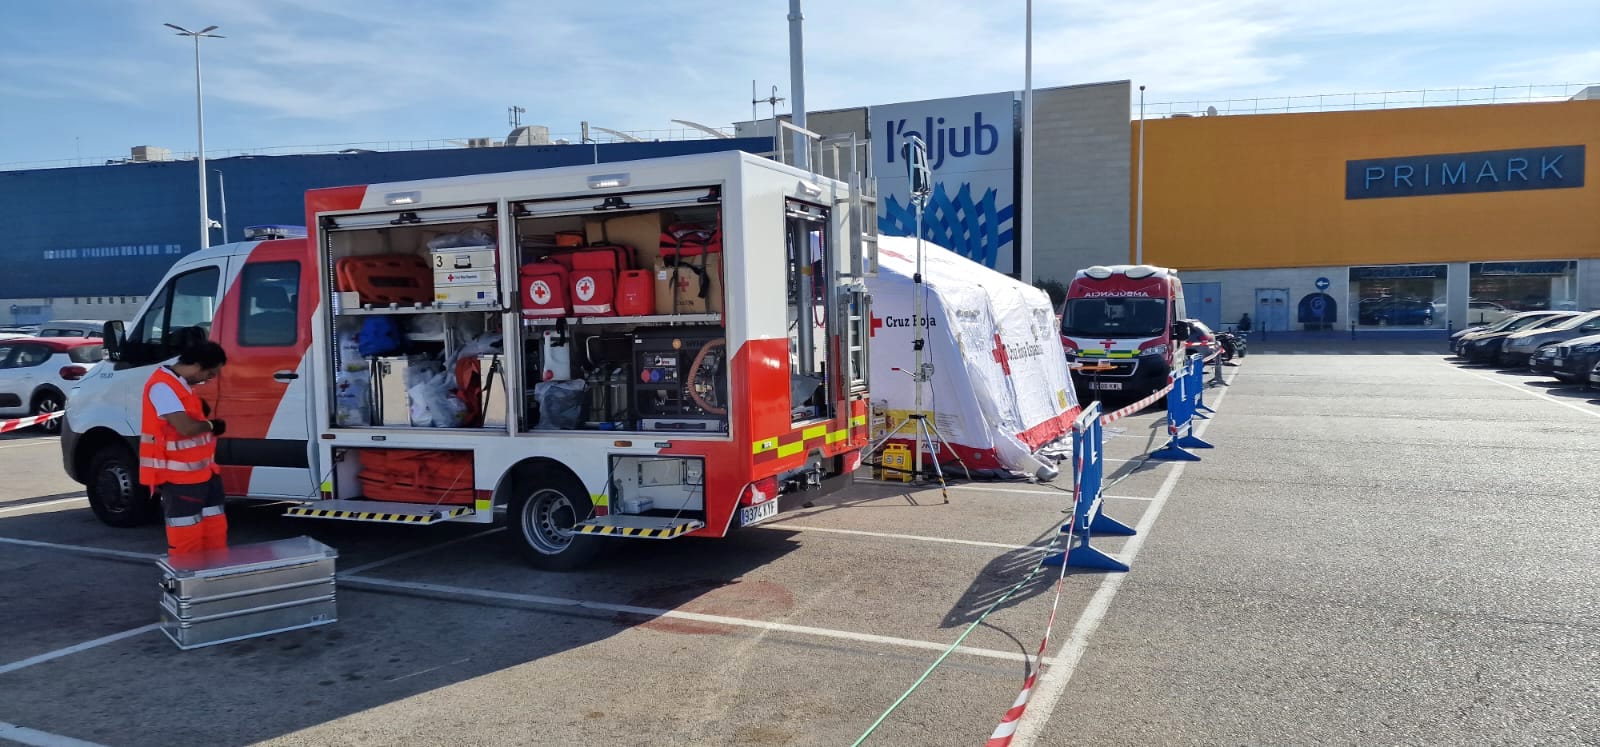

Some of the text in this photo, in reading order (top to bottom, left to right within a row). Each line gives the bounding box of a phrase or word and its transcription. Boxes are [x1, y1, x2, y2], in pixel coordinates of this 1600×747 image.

[1365, 154, 1564, 190] PRIMARK
[436, 255, 443, 268] 3
[886, 315, 910, 328] Cruz
